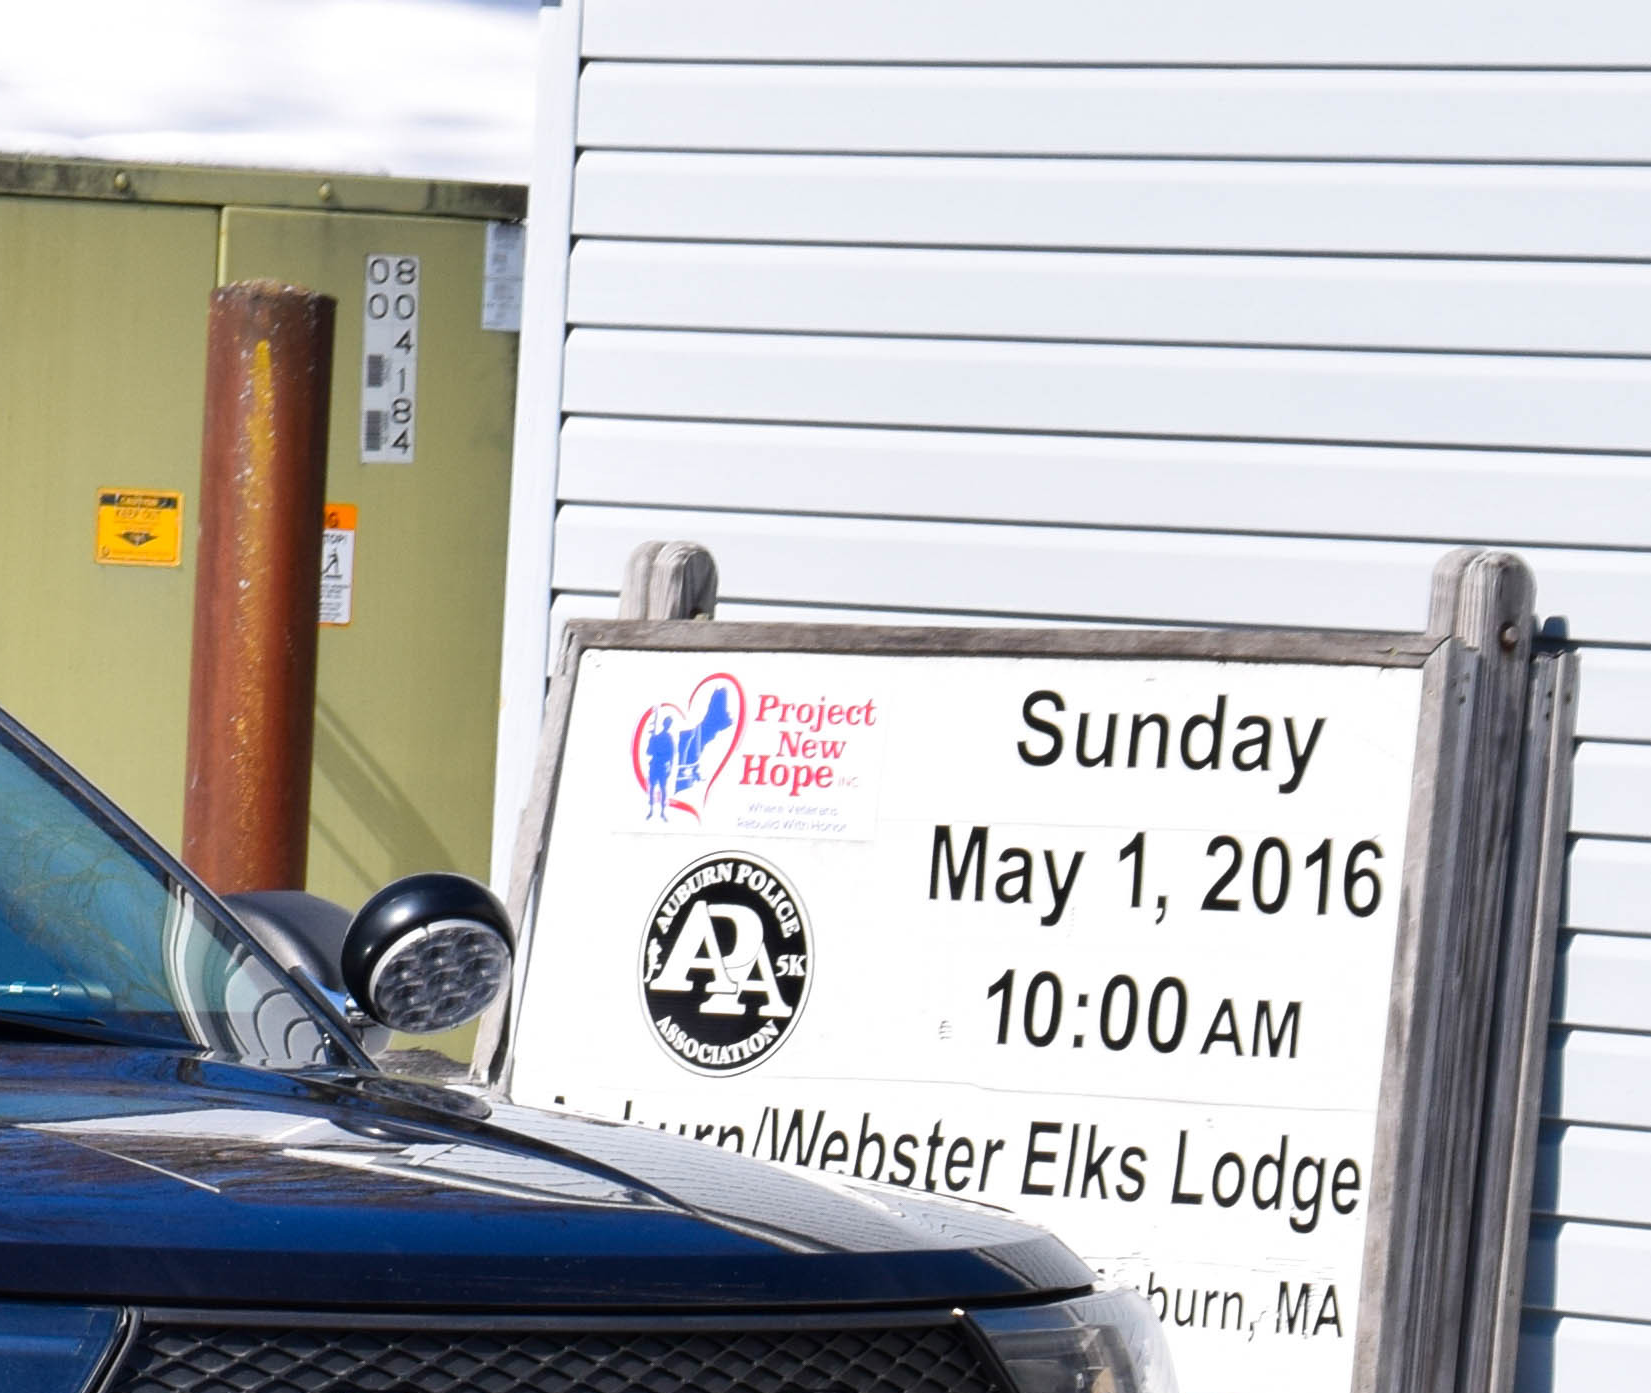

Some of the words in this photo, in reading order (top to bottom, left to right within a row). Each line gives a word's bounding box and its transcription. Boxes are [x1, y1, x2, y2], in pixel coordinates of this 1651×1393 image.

[754, 694, 876, 733] Project
[1017, 690, 1326, 794] Sunday
[775, 731, 847, 759] New
[738, 754, 835, 797] Hope
[655, 862, 734, 935] AUBURN
[734, 863, 801, 939] POLICE
[929, 825, 1085, 927] May
[1118, 832, 1169, 925] 1,
[1201, 835, 1384, 918] 2016
[775, 953, 806, 977] 5K
[655, 1015, 780, 1065] ASSOCIATION
[987, 969, 1187, 1055] 10:00
[1200, 998, 1302, 1059] AM
[1021, 1121, 1148, 1202] Elks
[1171, 1130, 1361, 1235] Lodge
[1274, 1280, 1344, 1338] MA
